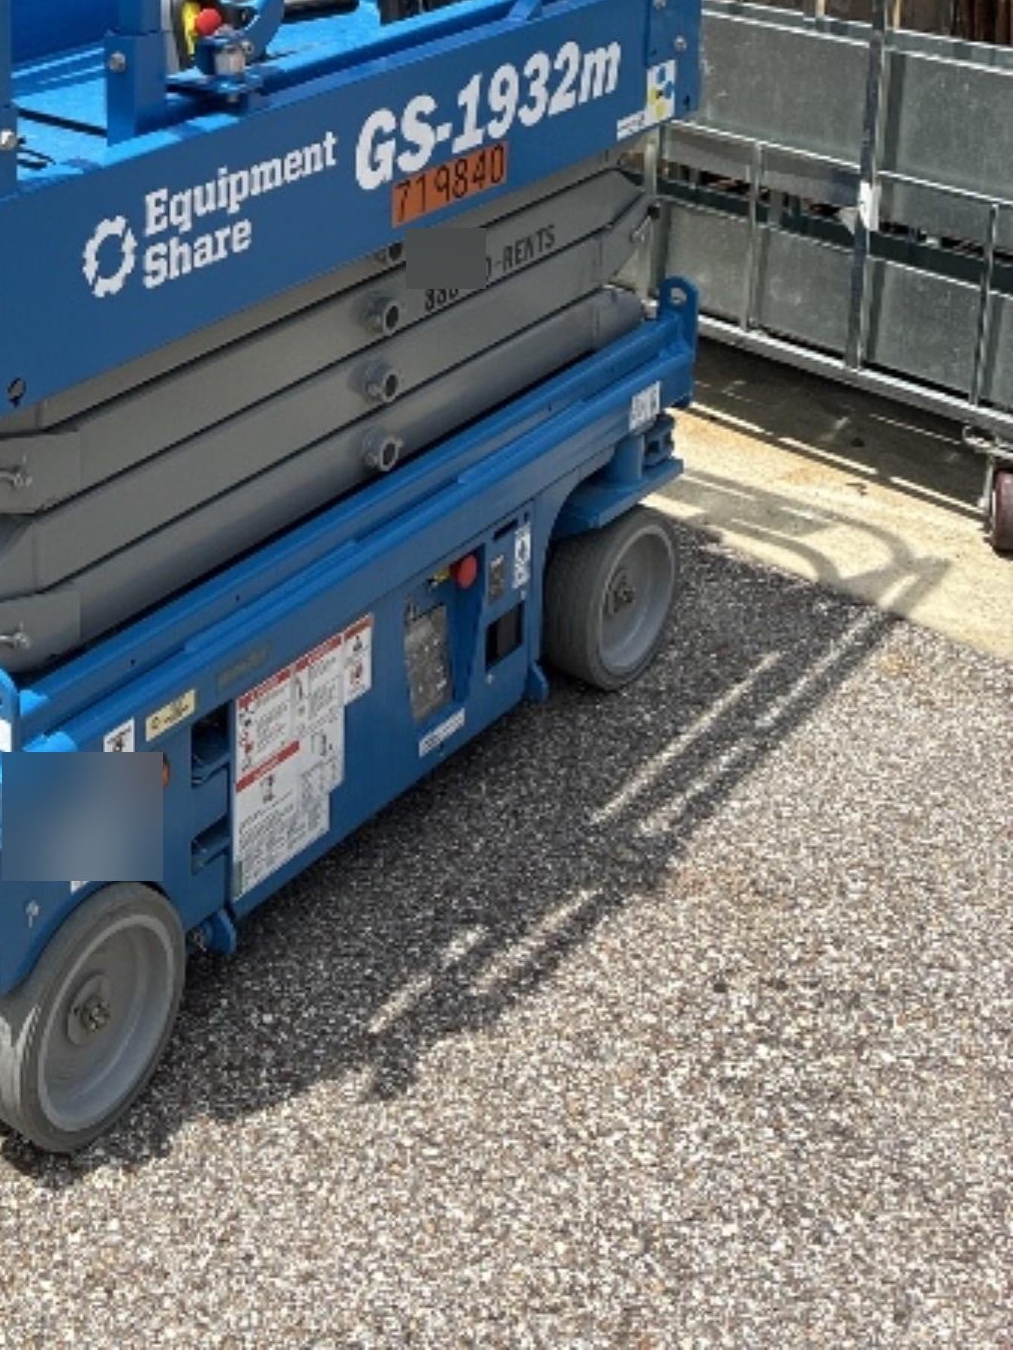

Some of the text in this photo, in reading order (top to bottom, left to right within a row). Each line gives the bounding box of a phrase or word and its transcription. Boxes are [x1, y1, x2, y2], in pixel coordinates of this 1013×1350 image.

[356, 41, 621, 190] GS-1932m
[144, 131, 336, 237] Equipment
[394, 144, 505, 222] 719840
[143, 218, 252, 288] Share
